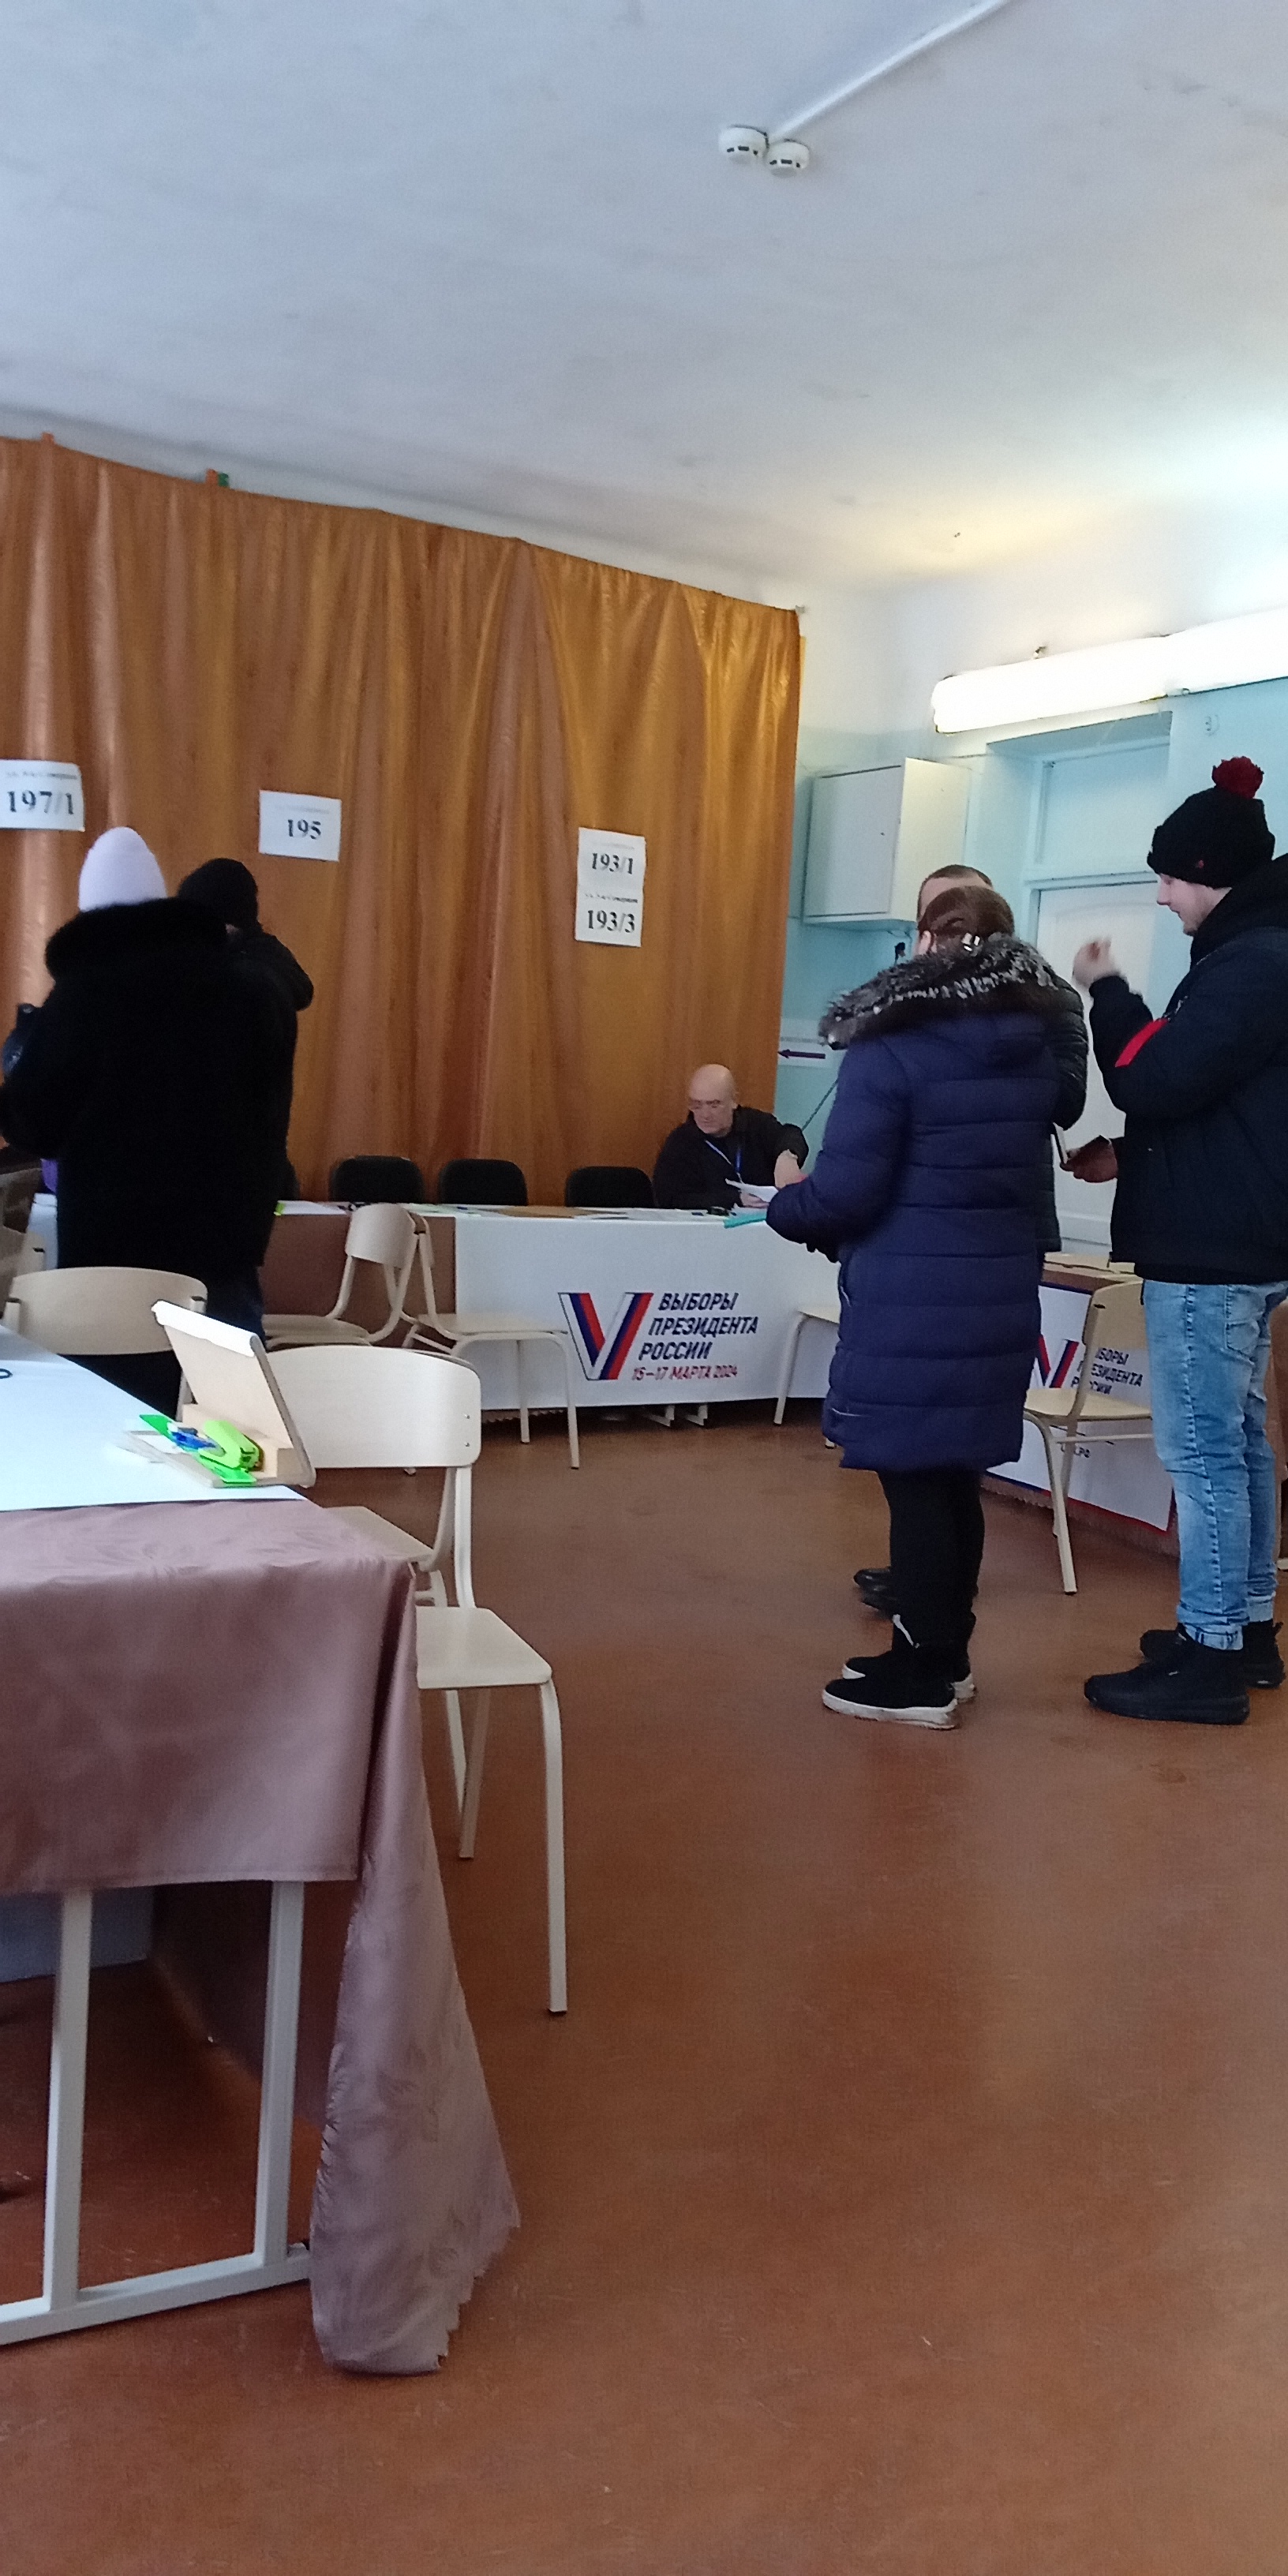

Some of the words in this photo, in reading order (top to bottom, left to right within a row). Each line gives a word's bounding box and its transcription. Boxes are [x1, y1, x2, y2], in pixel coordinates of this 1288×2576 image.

[7, 789, 74, 815] 197/1
[287, 819, 321, 840] 195
[592, 852, 633, 874] 193/1
[588, 909, 635, 934] 193/3
[657, 1292, 739, 1312] ВЫБОРЫ
[648, 1316, 759, 1338] ПРЕЗИДЕНТА
[638, 1342, 713, 1361] РОССИИ
[668, 1365, 712, 1380] МАРТА
